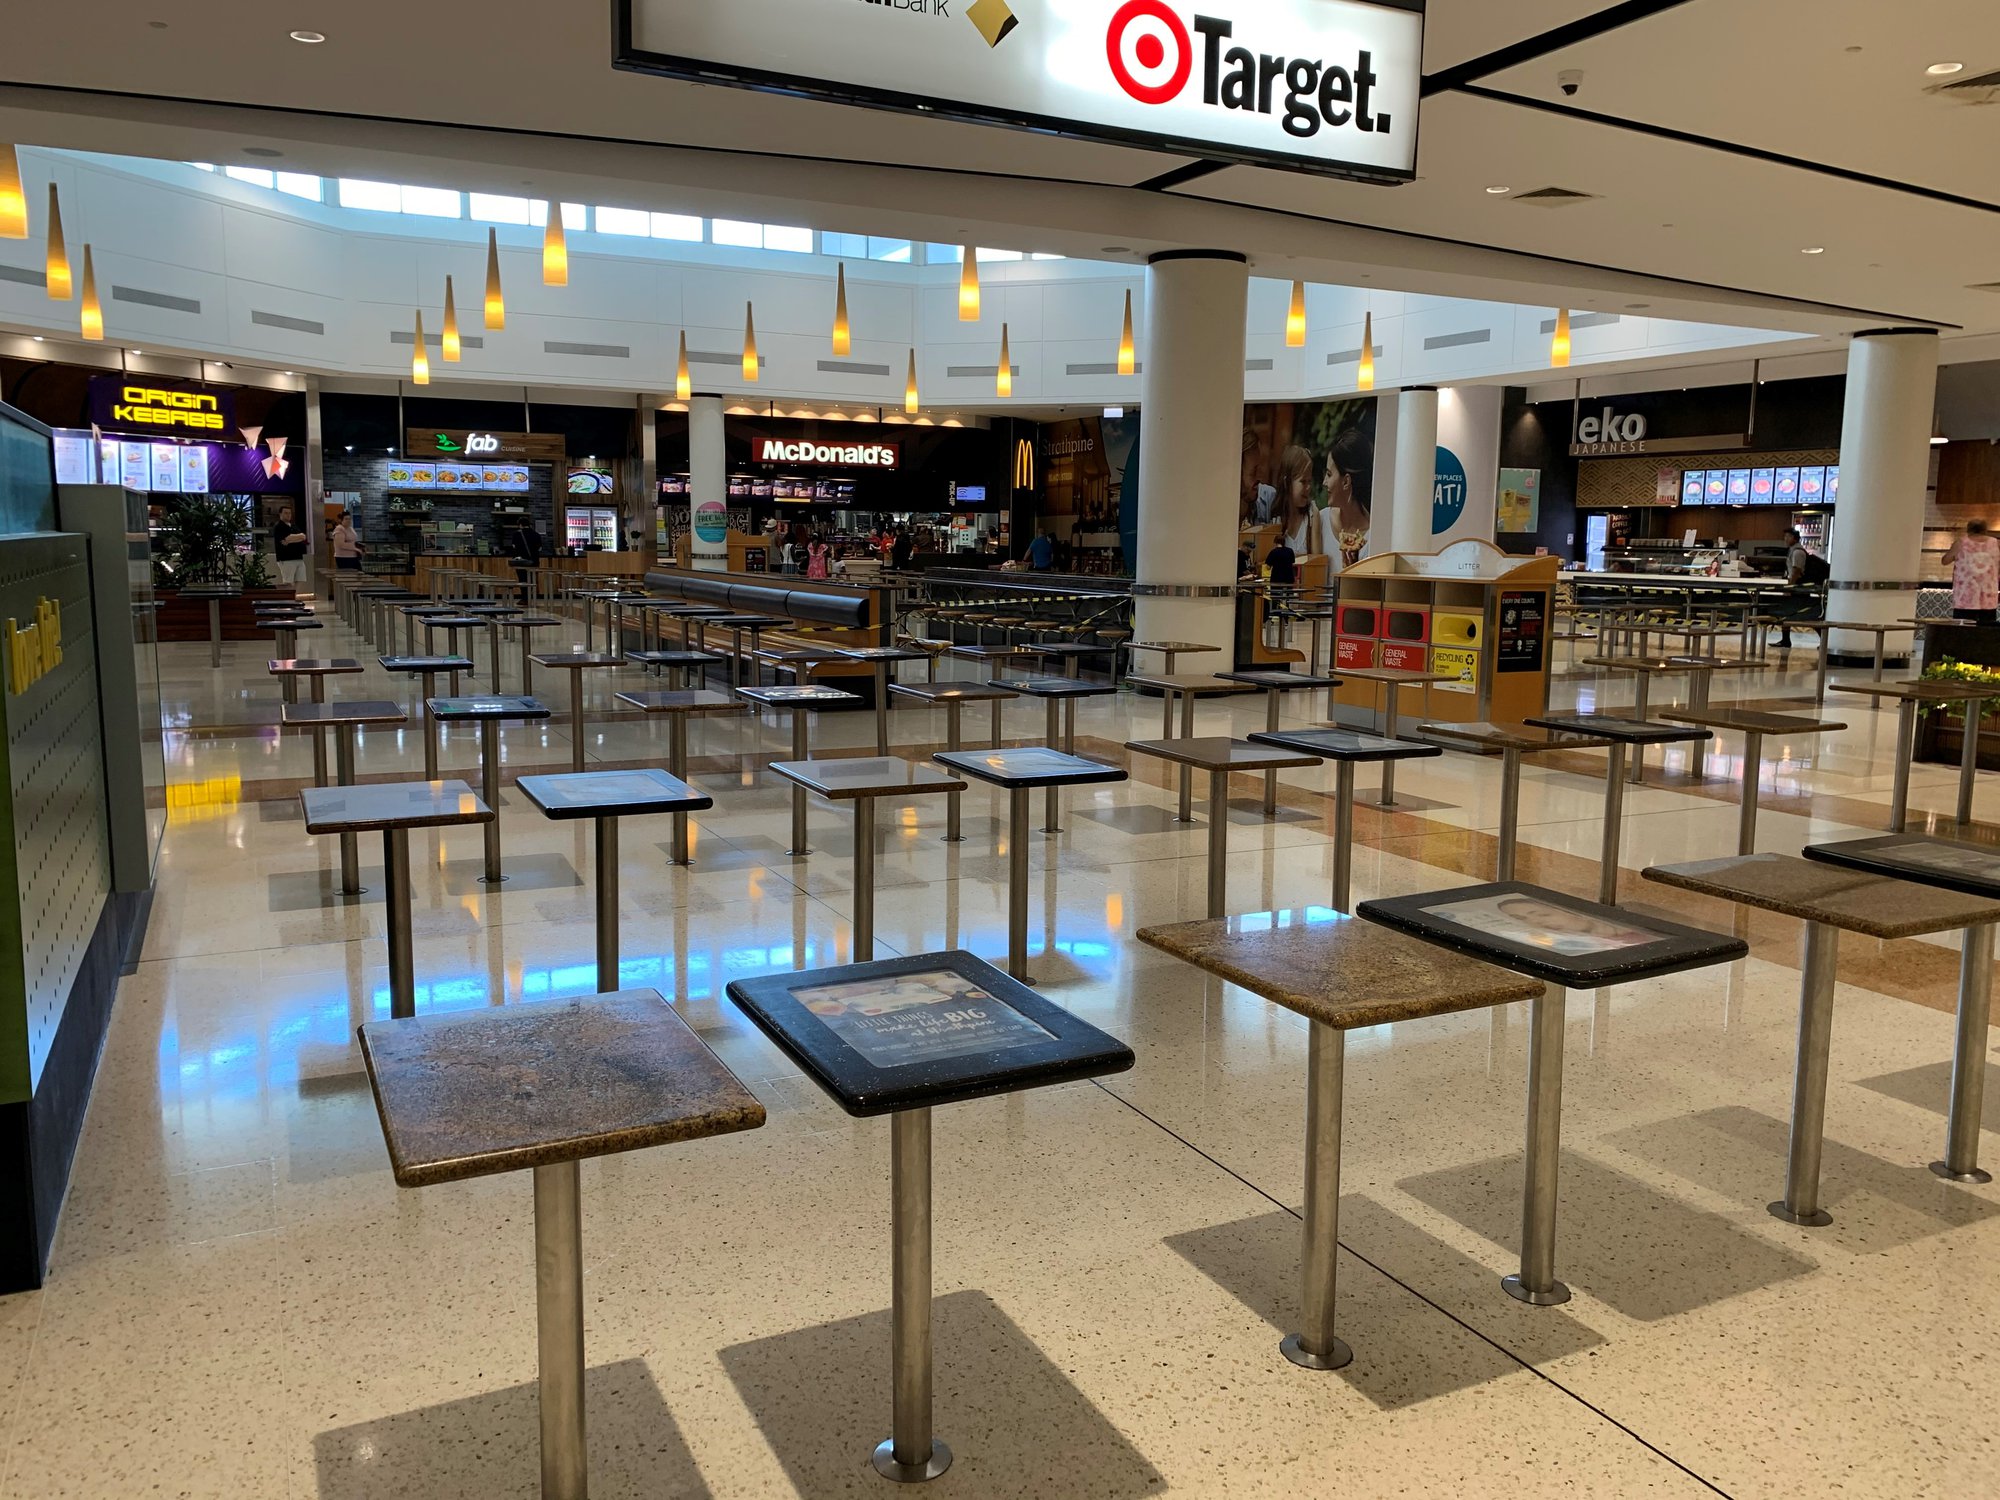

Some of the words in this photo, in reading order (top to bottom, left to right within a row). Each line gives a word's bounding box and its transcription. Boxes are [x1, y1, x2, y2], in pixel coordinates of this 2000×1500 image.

[1194, 14, 1391, 138] Target.
[114, 405, 224, 429] KEBABS
[1579, 407, 1646, 443] eko
[464, 433, 498, 455] fab
[762, 440, 895, 465] McDonald's
[1041, 435, 1094, 461] Strathpine
[1574, 441, 1646, 454] JAPANESE
[1443, 474, 1463, 482] PLACES
[1434, 483, 1461, 507] AT!
[1338, 641, 1358, 652] GENERAL
[1338, 650, 1354, 660] WASTE
[1385, 648, 1407, 659] GENERAL
[1385, 658, 1402, 667] WASTE
[1436, 652, 1463, 663] RECYCLING
[855, 1014, 891, 1029] LITTLE
[893, 1011, 933, 1024] THINGS
[876, 1022, 917, 1035] make
[944, 1008, 987, 1023] BIG
